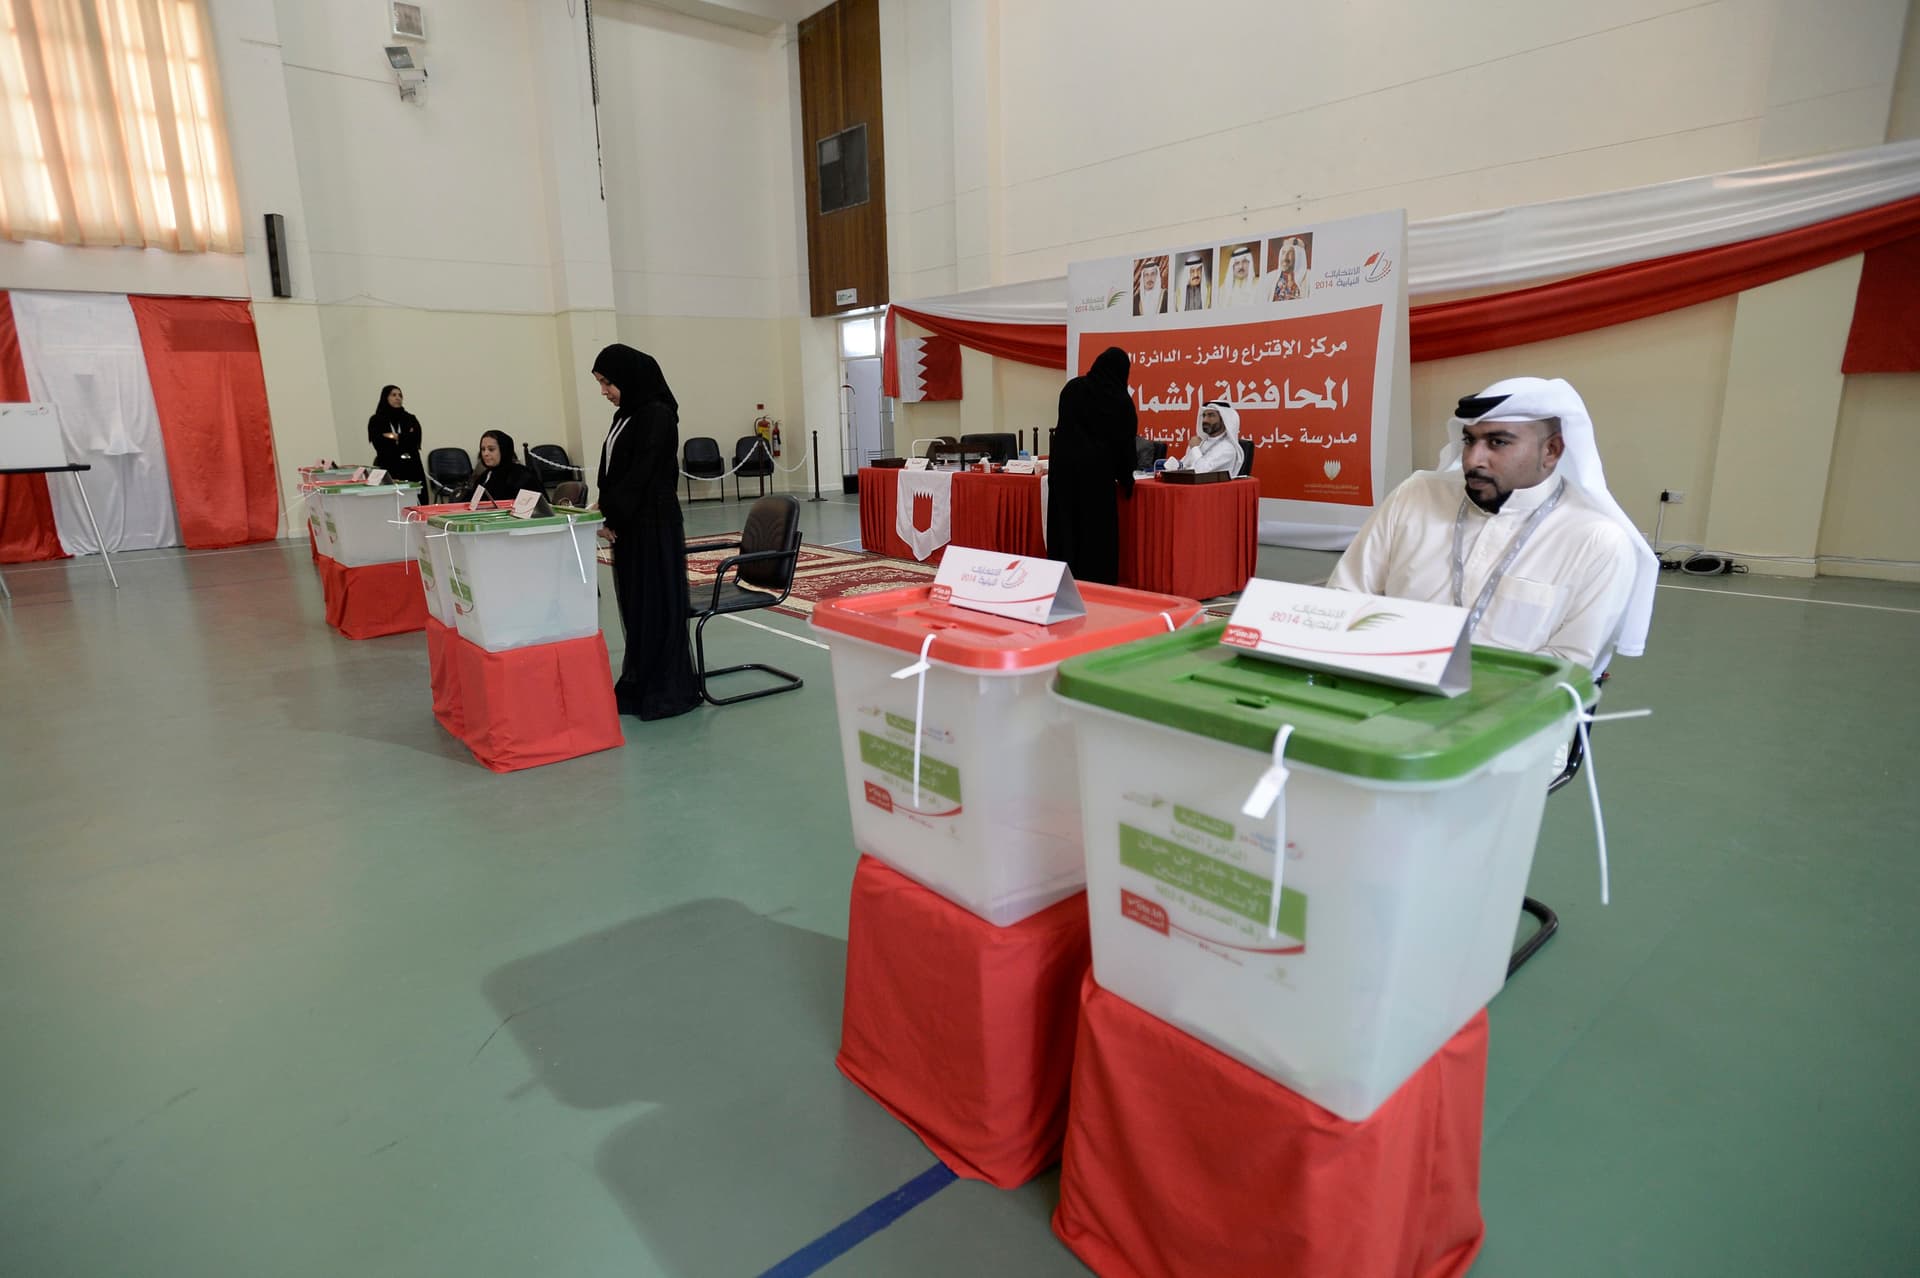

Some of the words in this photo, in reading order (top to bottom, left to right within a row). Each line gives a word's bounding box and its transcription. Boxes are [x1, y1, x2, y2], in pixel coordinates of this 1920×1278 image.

[1315, 279, 1333, 289] 2014
[1139, 349, 1180, 367] الدائرة
[1193, 344, 1239, 365] والفرز
[1241, 339, 1301, 366] الإقتراع
[1303, 336, 1348, 358] مركز
[1127, 381, 1204, 413] الشما
[1214, 376, 1349, 411] المحافظة
[1139, 427, 1190, 447] الإبتدائ
[1255, 427, 1294, 449] جابر
[1299, 427, 1358, 449] مدرسة
[1269, 610, 1300, 625] 2014
